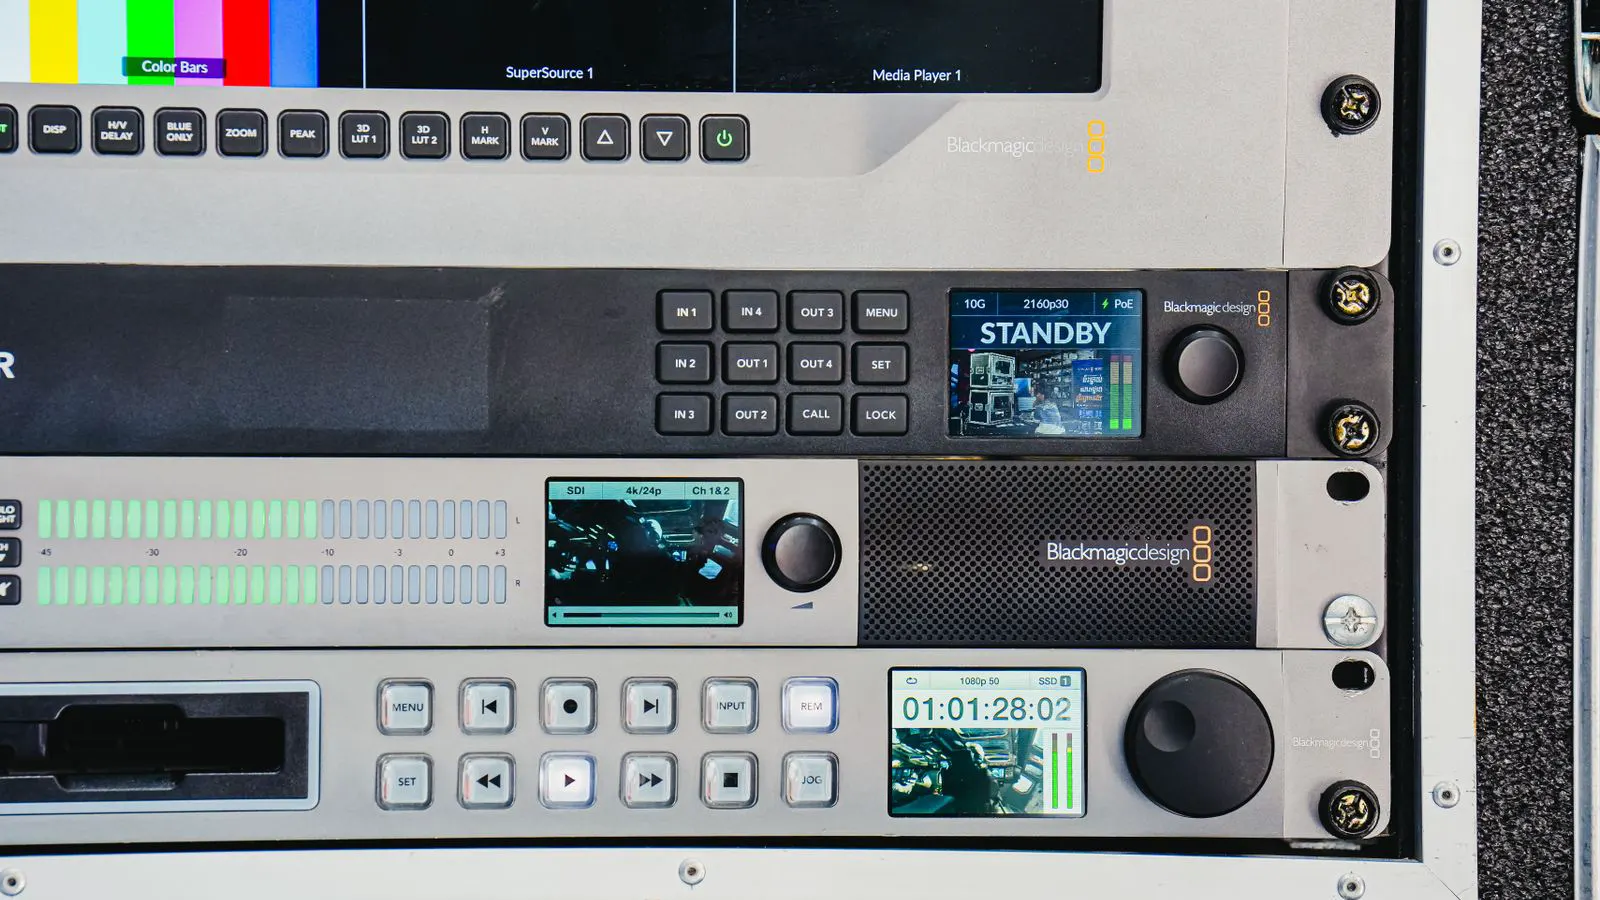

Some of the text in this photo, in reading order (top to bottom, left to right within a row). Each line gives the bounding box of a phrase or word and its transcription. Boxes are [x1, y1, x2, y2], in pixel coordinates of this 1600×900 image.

[141, 60, 208, 74] Color Bars
[506, 66, 593, 80] SuperSource 1
[872, 69, 962, 84] Media Player 1
[43, 125, 67, 134] DISP
[108, 121, 128, 130] H/V
[167, 122, 192, 131] BLUE
[356, 124, 370, 133] 3D
[417, 125, 431, 134] 3D
[481, 125, 489, 134] H
[101, 131, 133, 141] DELAY
[225, 128, 257, 138] ZOOM
[290, 129, 316, 138] PEAK
[541, 127, 549, 135] V
[166, 132, 193, 142] ONLY
[351, 134, 377, 144] LUT 1
[411, 135, 438, 145] LUT 2
[471, 135, 499, 145] MARK
[531, 136, 559, 146] MARK
[964, 299, 986, 309] 10G
[1023, 298, 1069, 311] 2160p30
[1114, 298, 1134, 309] PoE
[677, 307, 697, 317] IN 1
[741, 307, 762, 317] IN 4
[800, 308, 834, 318] OUT 3
[865, 308, 898, 318] MENU
[980, 321, 1112, 345] STANDBY
[675, 358, 696, 368] IN 2
[736, 358, 768, 368] OUT 1
[800, 359, 833, 369] OUT 4
[871, 360, 891, 370] SET
[674, 409, 695, 419] IN 3
[735, 410, 768, 420] OUT 2
[802, 408, 830, 419] CALL
[865, 410, 897, 420] LOCK
[567, 486, 585, 495] SDI
[625, 486, 662, 497] 4k/24p
[692, 486, 707, 496] Ch
[146, 548, 160, 557] -30
[234, 548, 248, 557] -20
[321, 548, 335, 557] -10
[394, 549, 402, 557] -3
[448, 549, 454, 557] 0
[515, 579, 521, 587] R
[960, 677, 1000, 687] 1080p 50
[1038, 677, 1058, 686] SSD
[392, 703, 424, 712] MENU
[716, 701, 746, 711] INPUT
[801, 702, 823, 711] REM
[902, 696, 1072, 721] 01:01:28:02
[398, 777, 416, 786] SET
[802, 775, 823, 785] JOG
